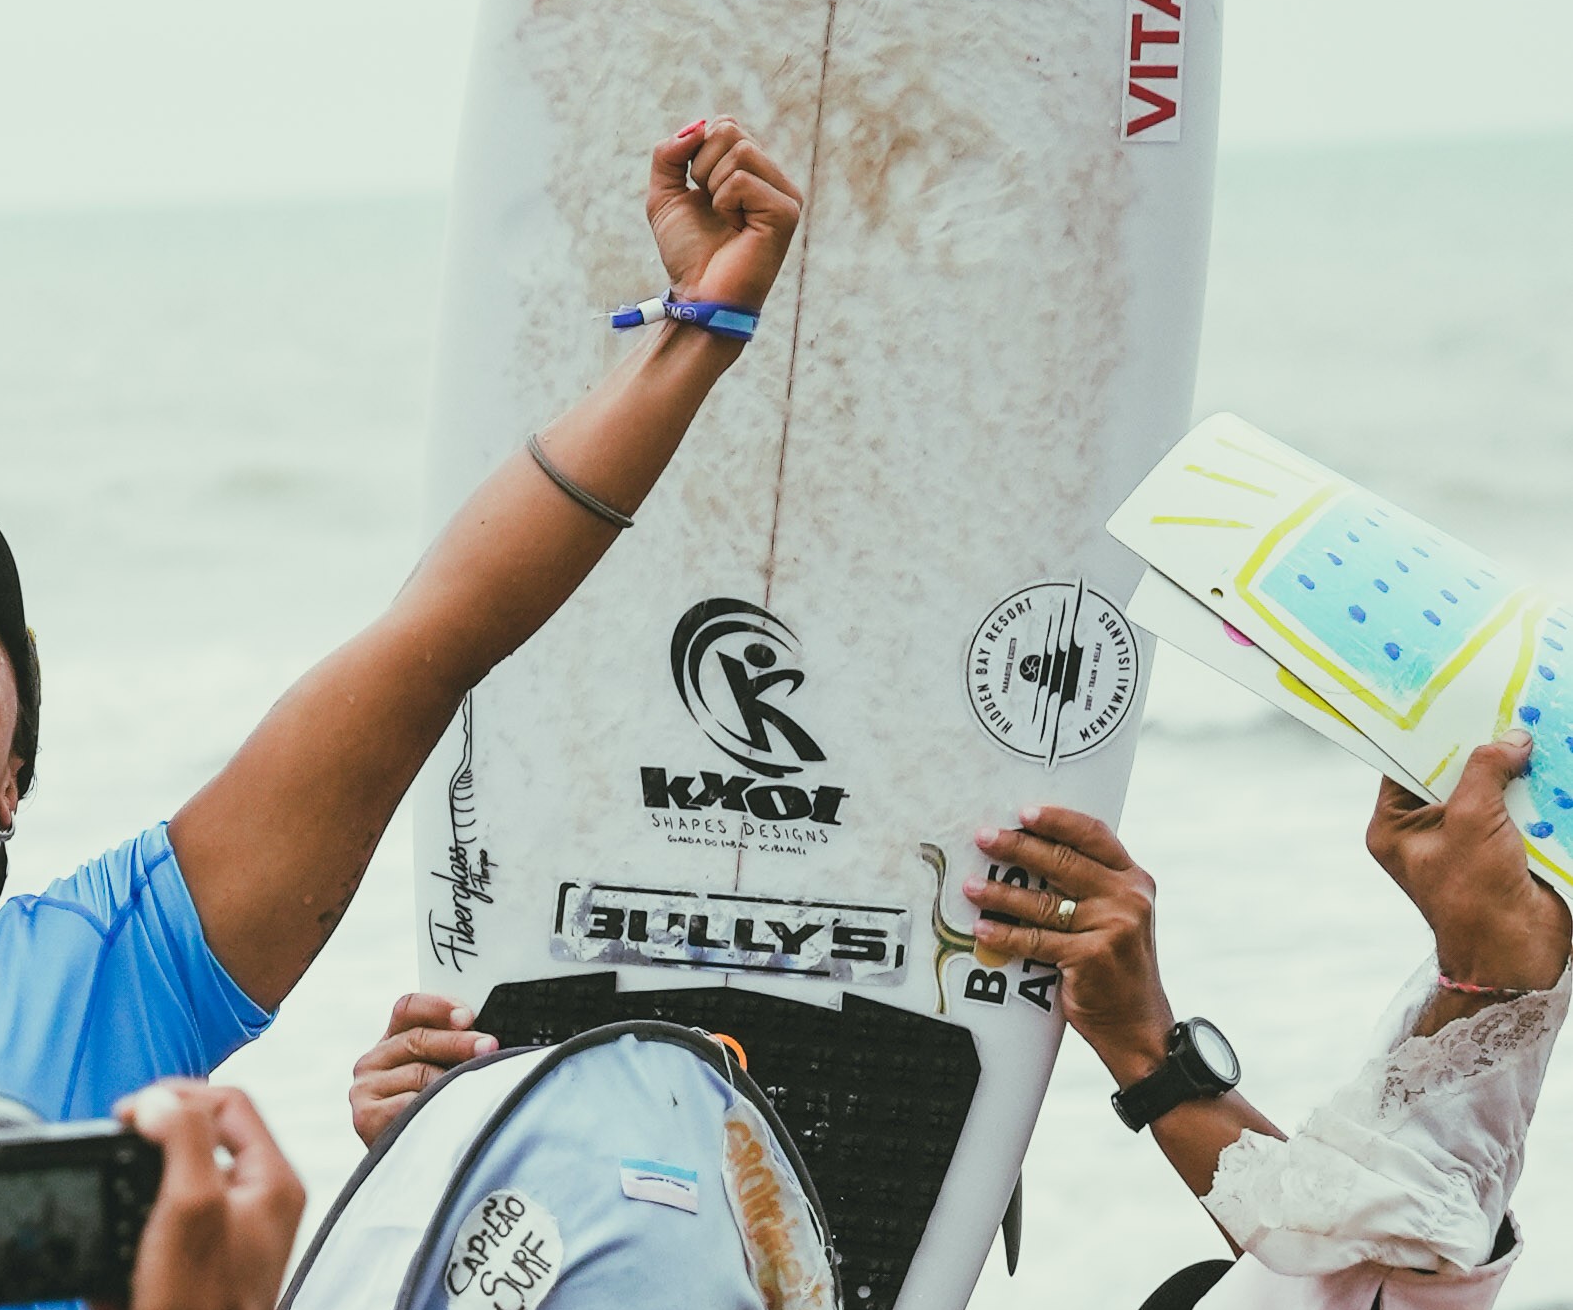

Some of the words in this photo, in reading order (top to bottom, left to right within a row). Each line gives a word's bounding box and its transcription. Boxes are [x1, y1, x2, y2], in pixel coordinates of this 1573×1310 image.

[985, 596, 1034, 643] RESORT
[1098, 611, 1131, 672] ISLANDS
[975, 647, 992, 676] BAY
[977, 683, 1013, 734] HIDDEN
[1079, 678, 1130, 742] MENTAWAI
[651, 813, 727, 834] SHAPES
[742, 821, 829, 844] DESIGNS
